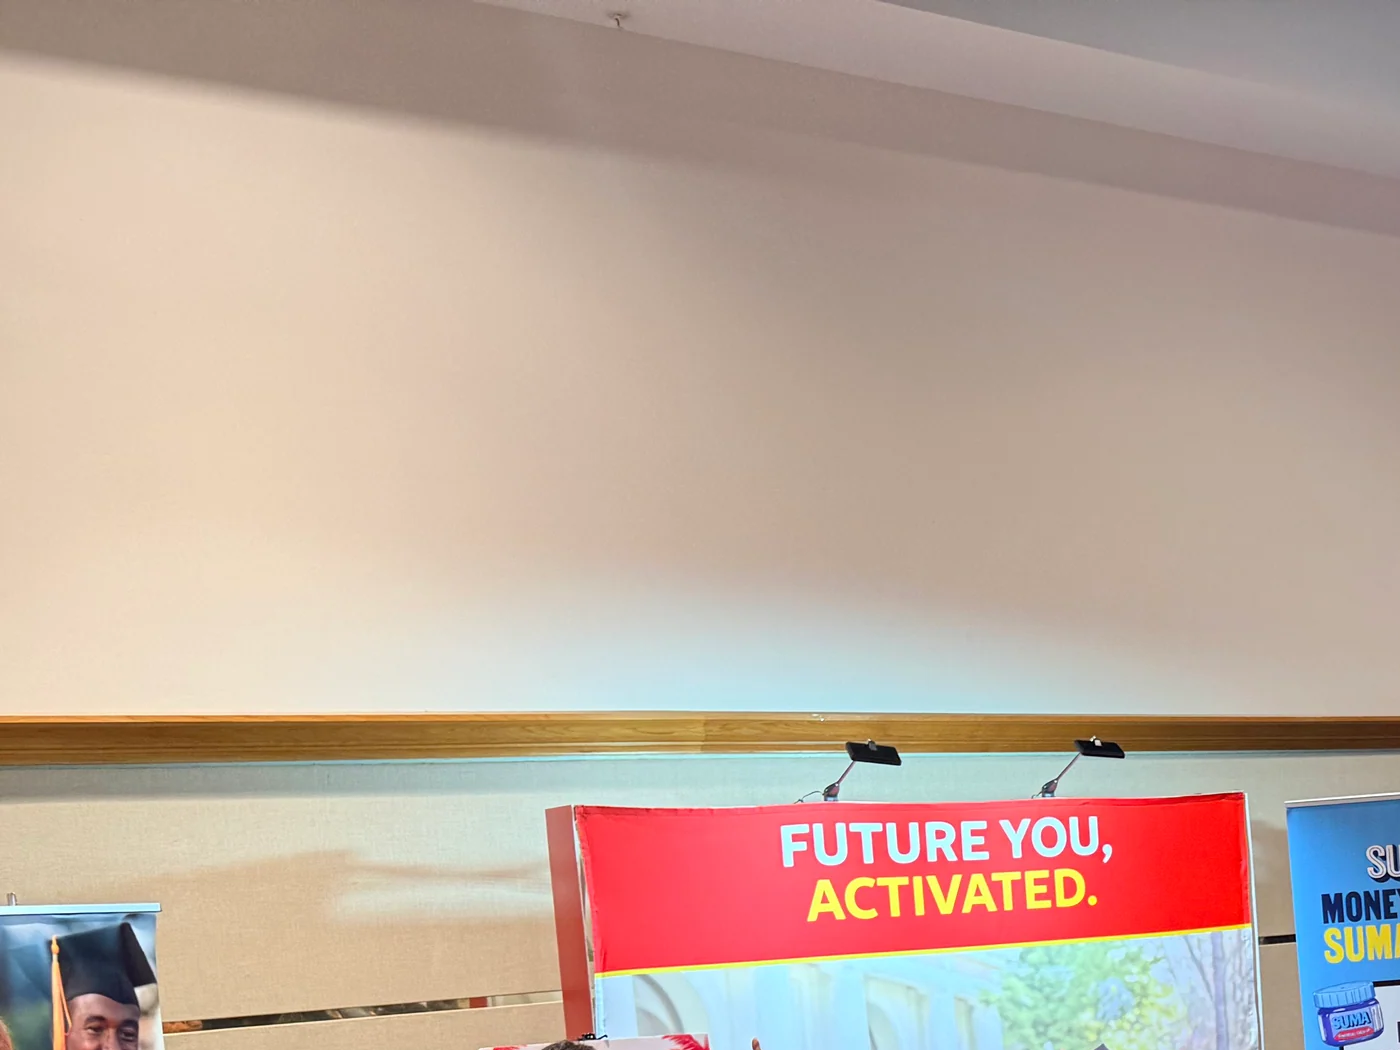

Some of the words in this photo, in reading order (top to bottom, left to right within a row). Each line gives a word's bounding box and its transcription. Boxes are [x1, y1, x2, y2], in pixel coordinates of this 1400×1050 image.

[780, 820, 990, 867] FUTURE
[999, 816, 1113, 863] YOU,
[806, 868, 1098, 922] ACTIVATED.
[1332, 1011, 1372, 1030] SUMA
